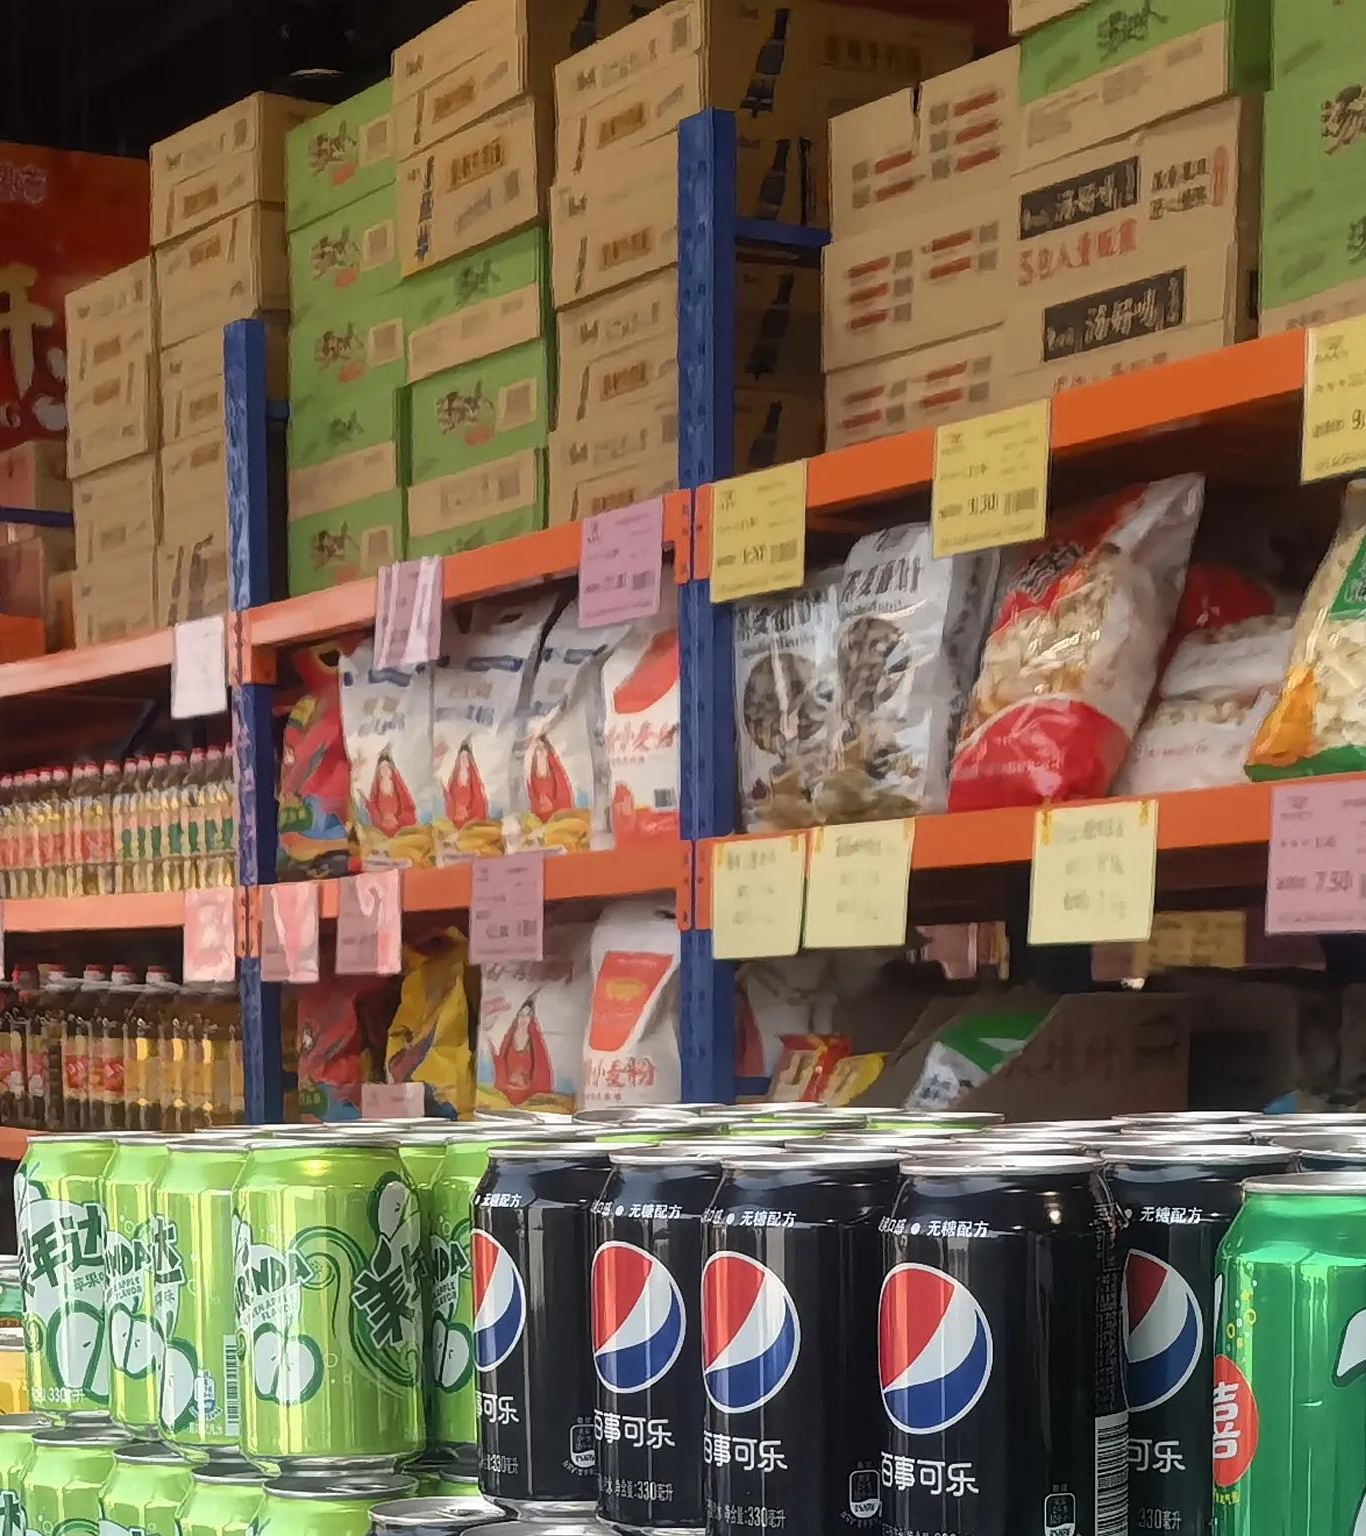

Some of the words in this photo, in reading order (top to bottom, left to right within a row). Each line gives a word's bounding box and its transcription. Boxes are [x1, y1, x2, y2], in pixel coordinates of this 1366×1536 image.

[481, 1191, 522, 1209] 无糖配方
[627, 1202, 683, 1221] 无糖配方
[739, 1209, 797, 1229] 无糖配方
[1139, 1205, 1203, 1225] 无糖配方
[926, 1218, 990, 1240] 无糖配方
[593, 1407, 676, 1450] 百事可乐
[703, 1429, 789, 1473] 百事可乐
[880, 1450, 980, 1498] 百事可乐
